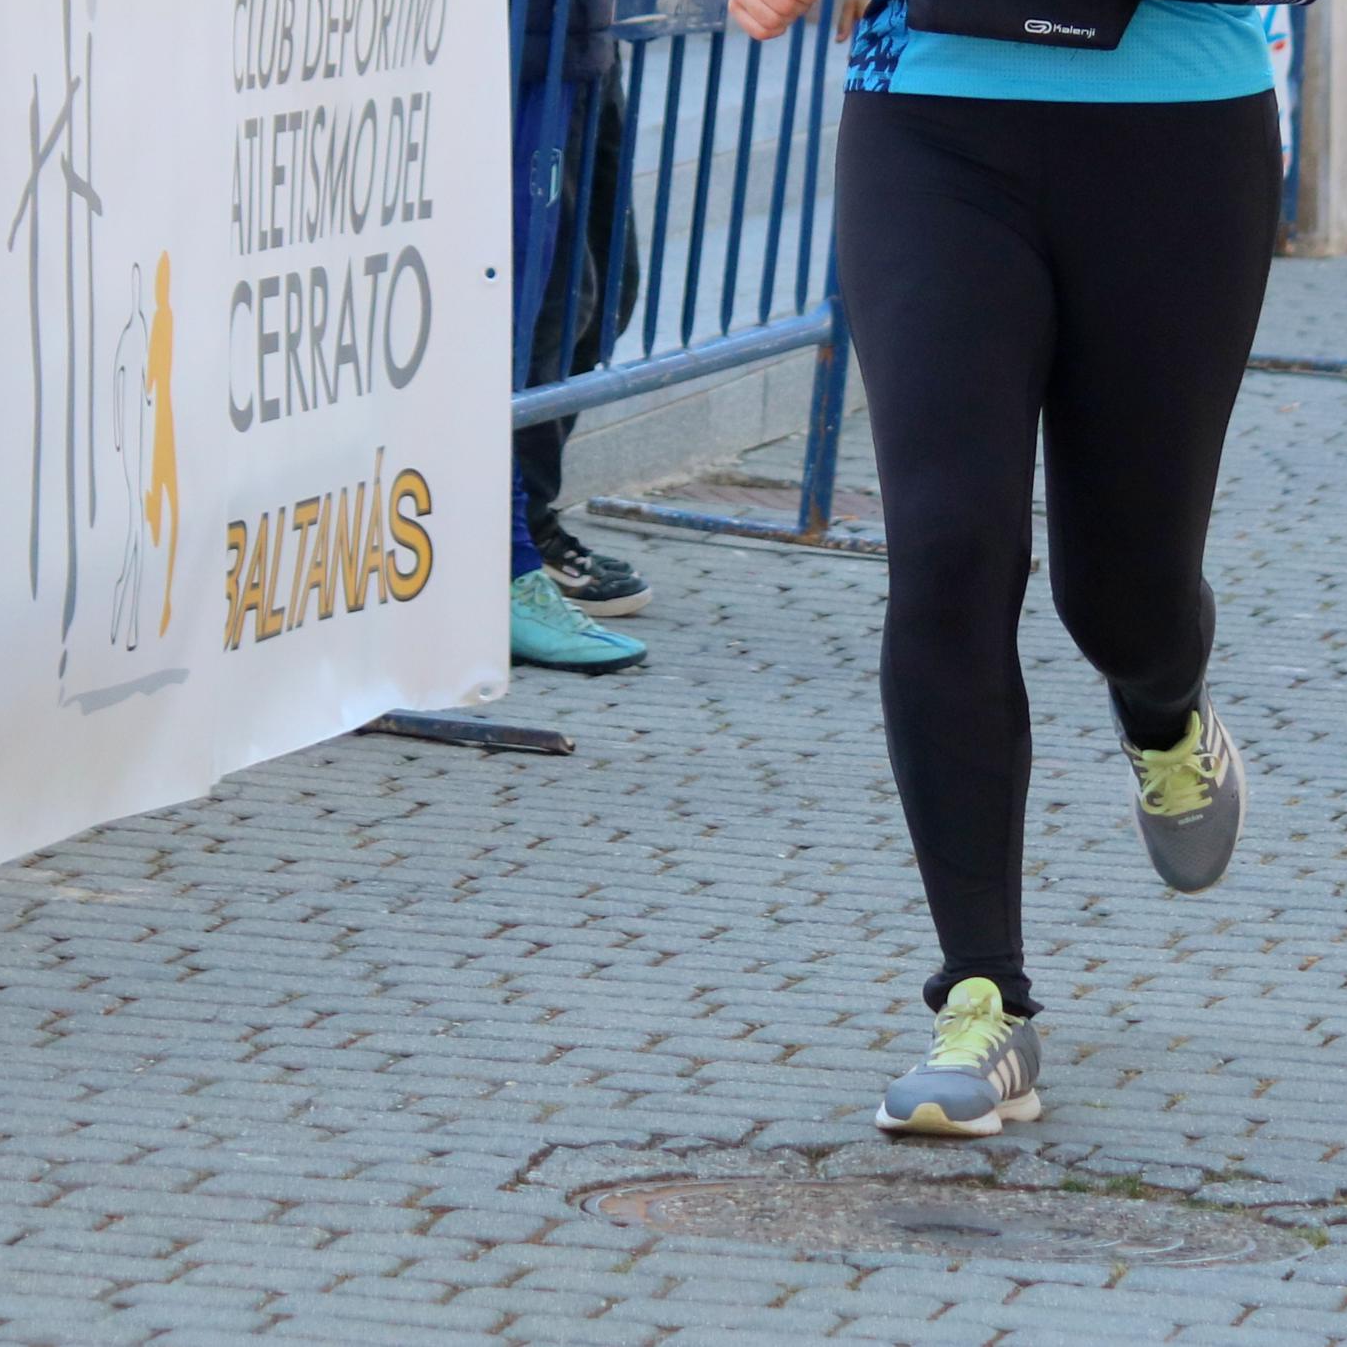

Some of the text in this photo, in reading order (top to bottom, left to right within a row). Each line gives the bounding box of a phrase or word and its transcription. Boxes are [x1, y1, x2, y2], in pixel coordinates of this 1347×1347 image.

[1053, 23, 1096, 38] Kalenji
[230, 91, 433, 257] ATLETISMO DEL
[228, 244, 432, 435] CERRATO
